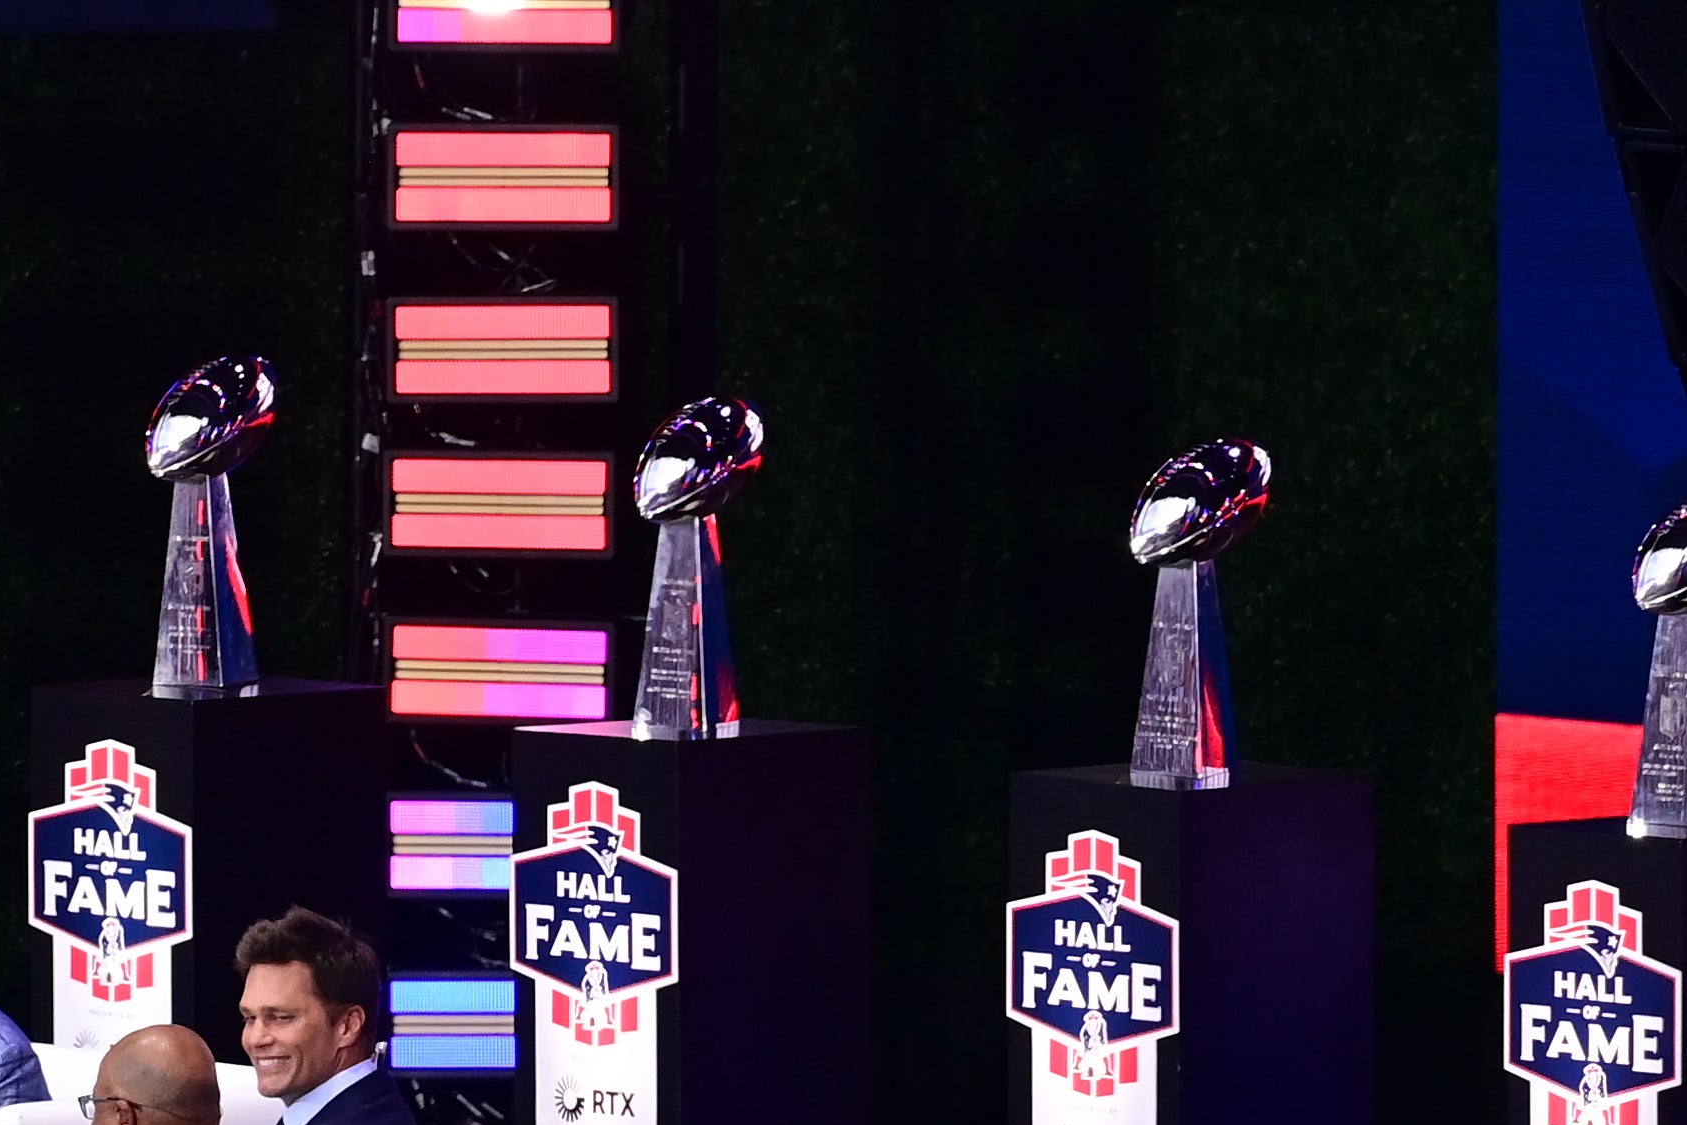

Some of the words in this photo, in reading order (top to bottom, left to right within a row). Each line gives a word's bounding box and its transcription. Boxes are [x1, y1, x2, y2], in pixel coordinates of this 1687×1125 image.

[73, 827, 147, 861] HALL
[42, 859, 176, 929] FAME
[556, 870, 631, 903] HALL
[524, 903, 661, 972] FAME
[1054, 918, 1131, 953] HALL
[1022, 950, 1162, 1022] FAME
[1553, 970, 1632, 1004] HALL
[1519, 1003, 1664, 1075] FAME
[592, 1089, 635, 1117] RTX
